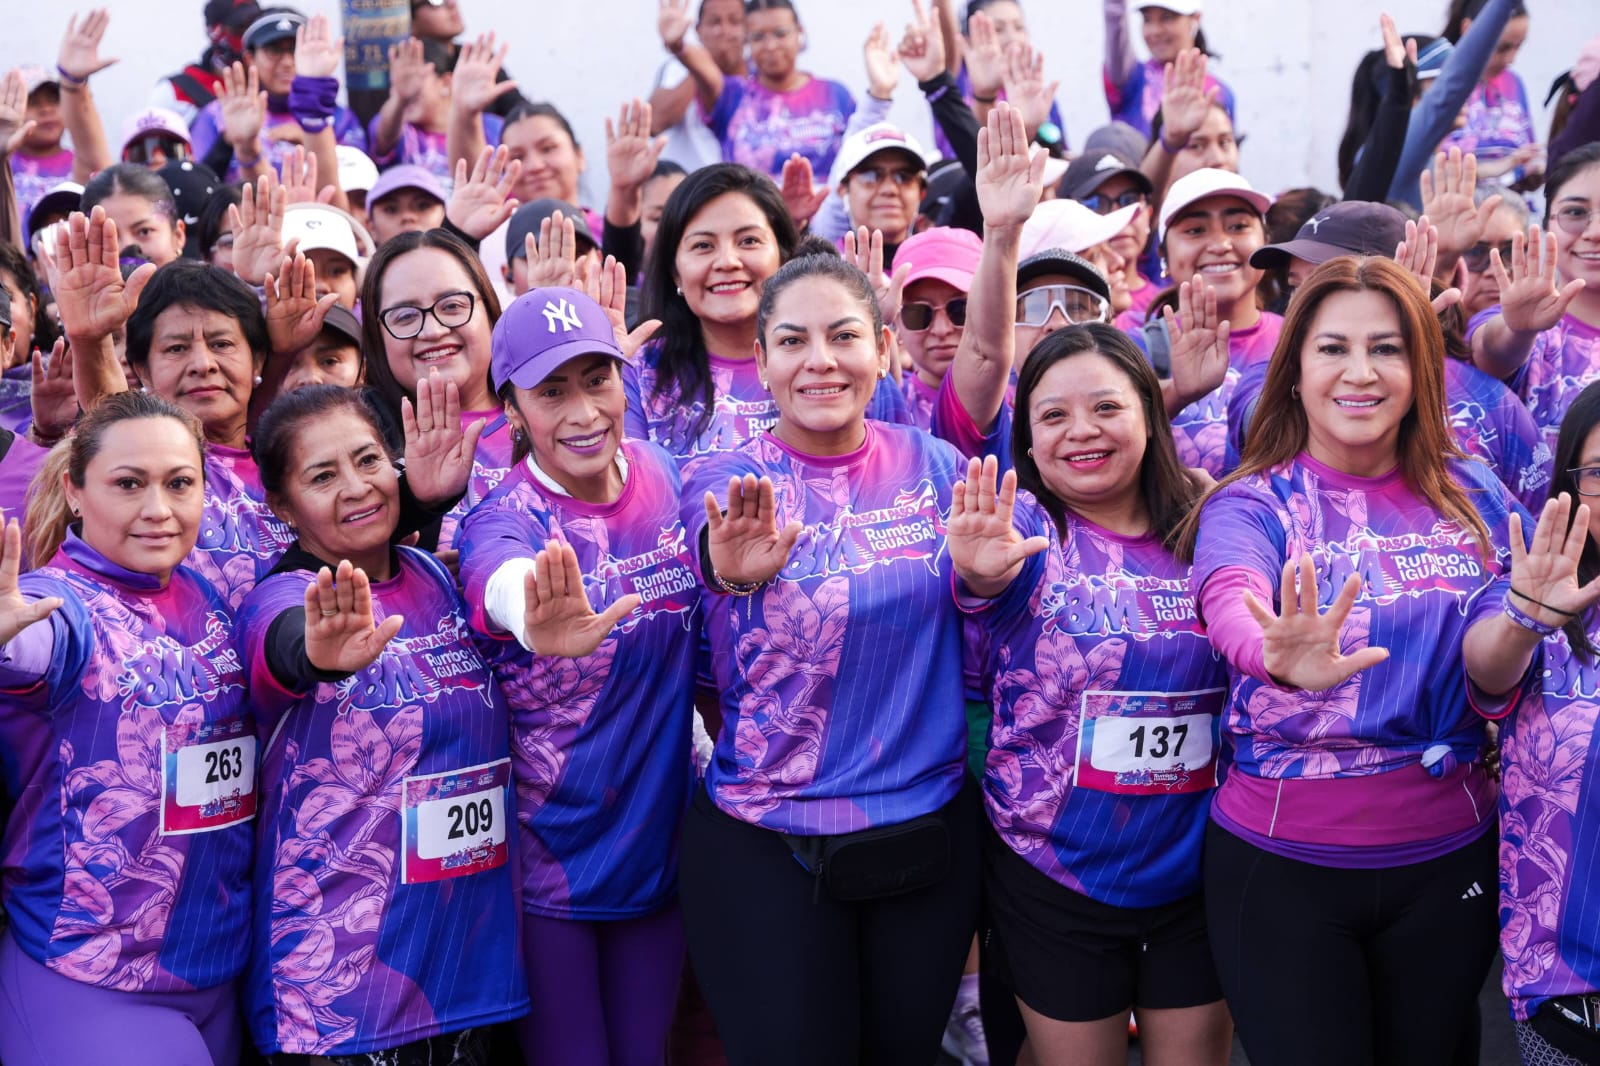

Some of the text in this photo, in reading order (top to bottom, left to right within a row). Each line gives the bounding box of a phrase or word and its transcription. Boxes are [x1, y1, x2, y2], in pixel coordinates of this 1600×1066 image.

[542, 298, 583, 334] NY
[736, 402, 766, 414] PASO
[849, 506, 916, 527] PASO A PASO
[865, 522, 922, 541] Rumbo
[870, 523, 937, 552] IGUALDAD
[1377, 534, 1455, 551] PASO A PASO
[617, 546, 675, 576] PASO A PASO
[1394, 552, 1460, 569] Rumbo
[1399, 560, 1480, 582] IGUALDAD
[632, 567, 681, 591] Rumbo
[638, 572, 697, 604] IGUALDAD
[1056, 584, 1141, 635] 8M
[1151, 594, 1195, 610] Rum
[1156, 608, 1198, 622] IGUA
[424, 650, 468, 667] Rumbo
[124, 643, 209, 706] 8M
[349, 652, 430, 710] 8M
[1129, 723, 1189, 759] 137
[204, 746, 242, 784] 263
[447, 798, 493, 840] 209
